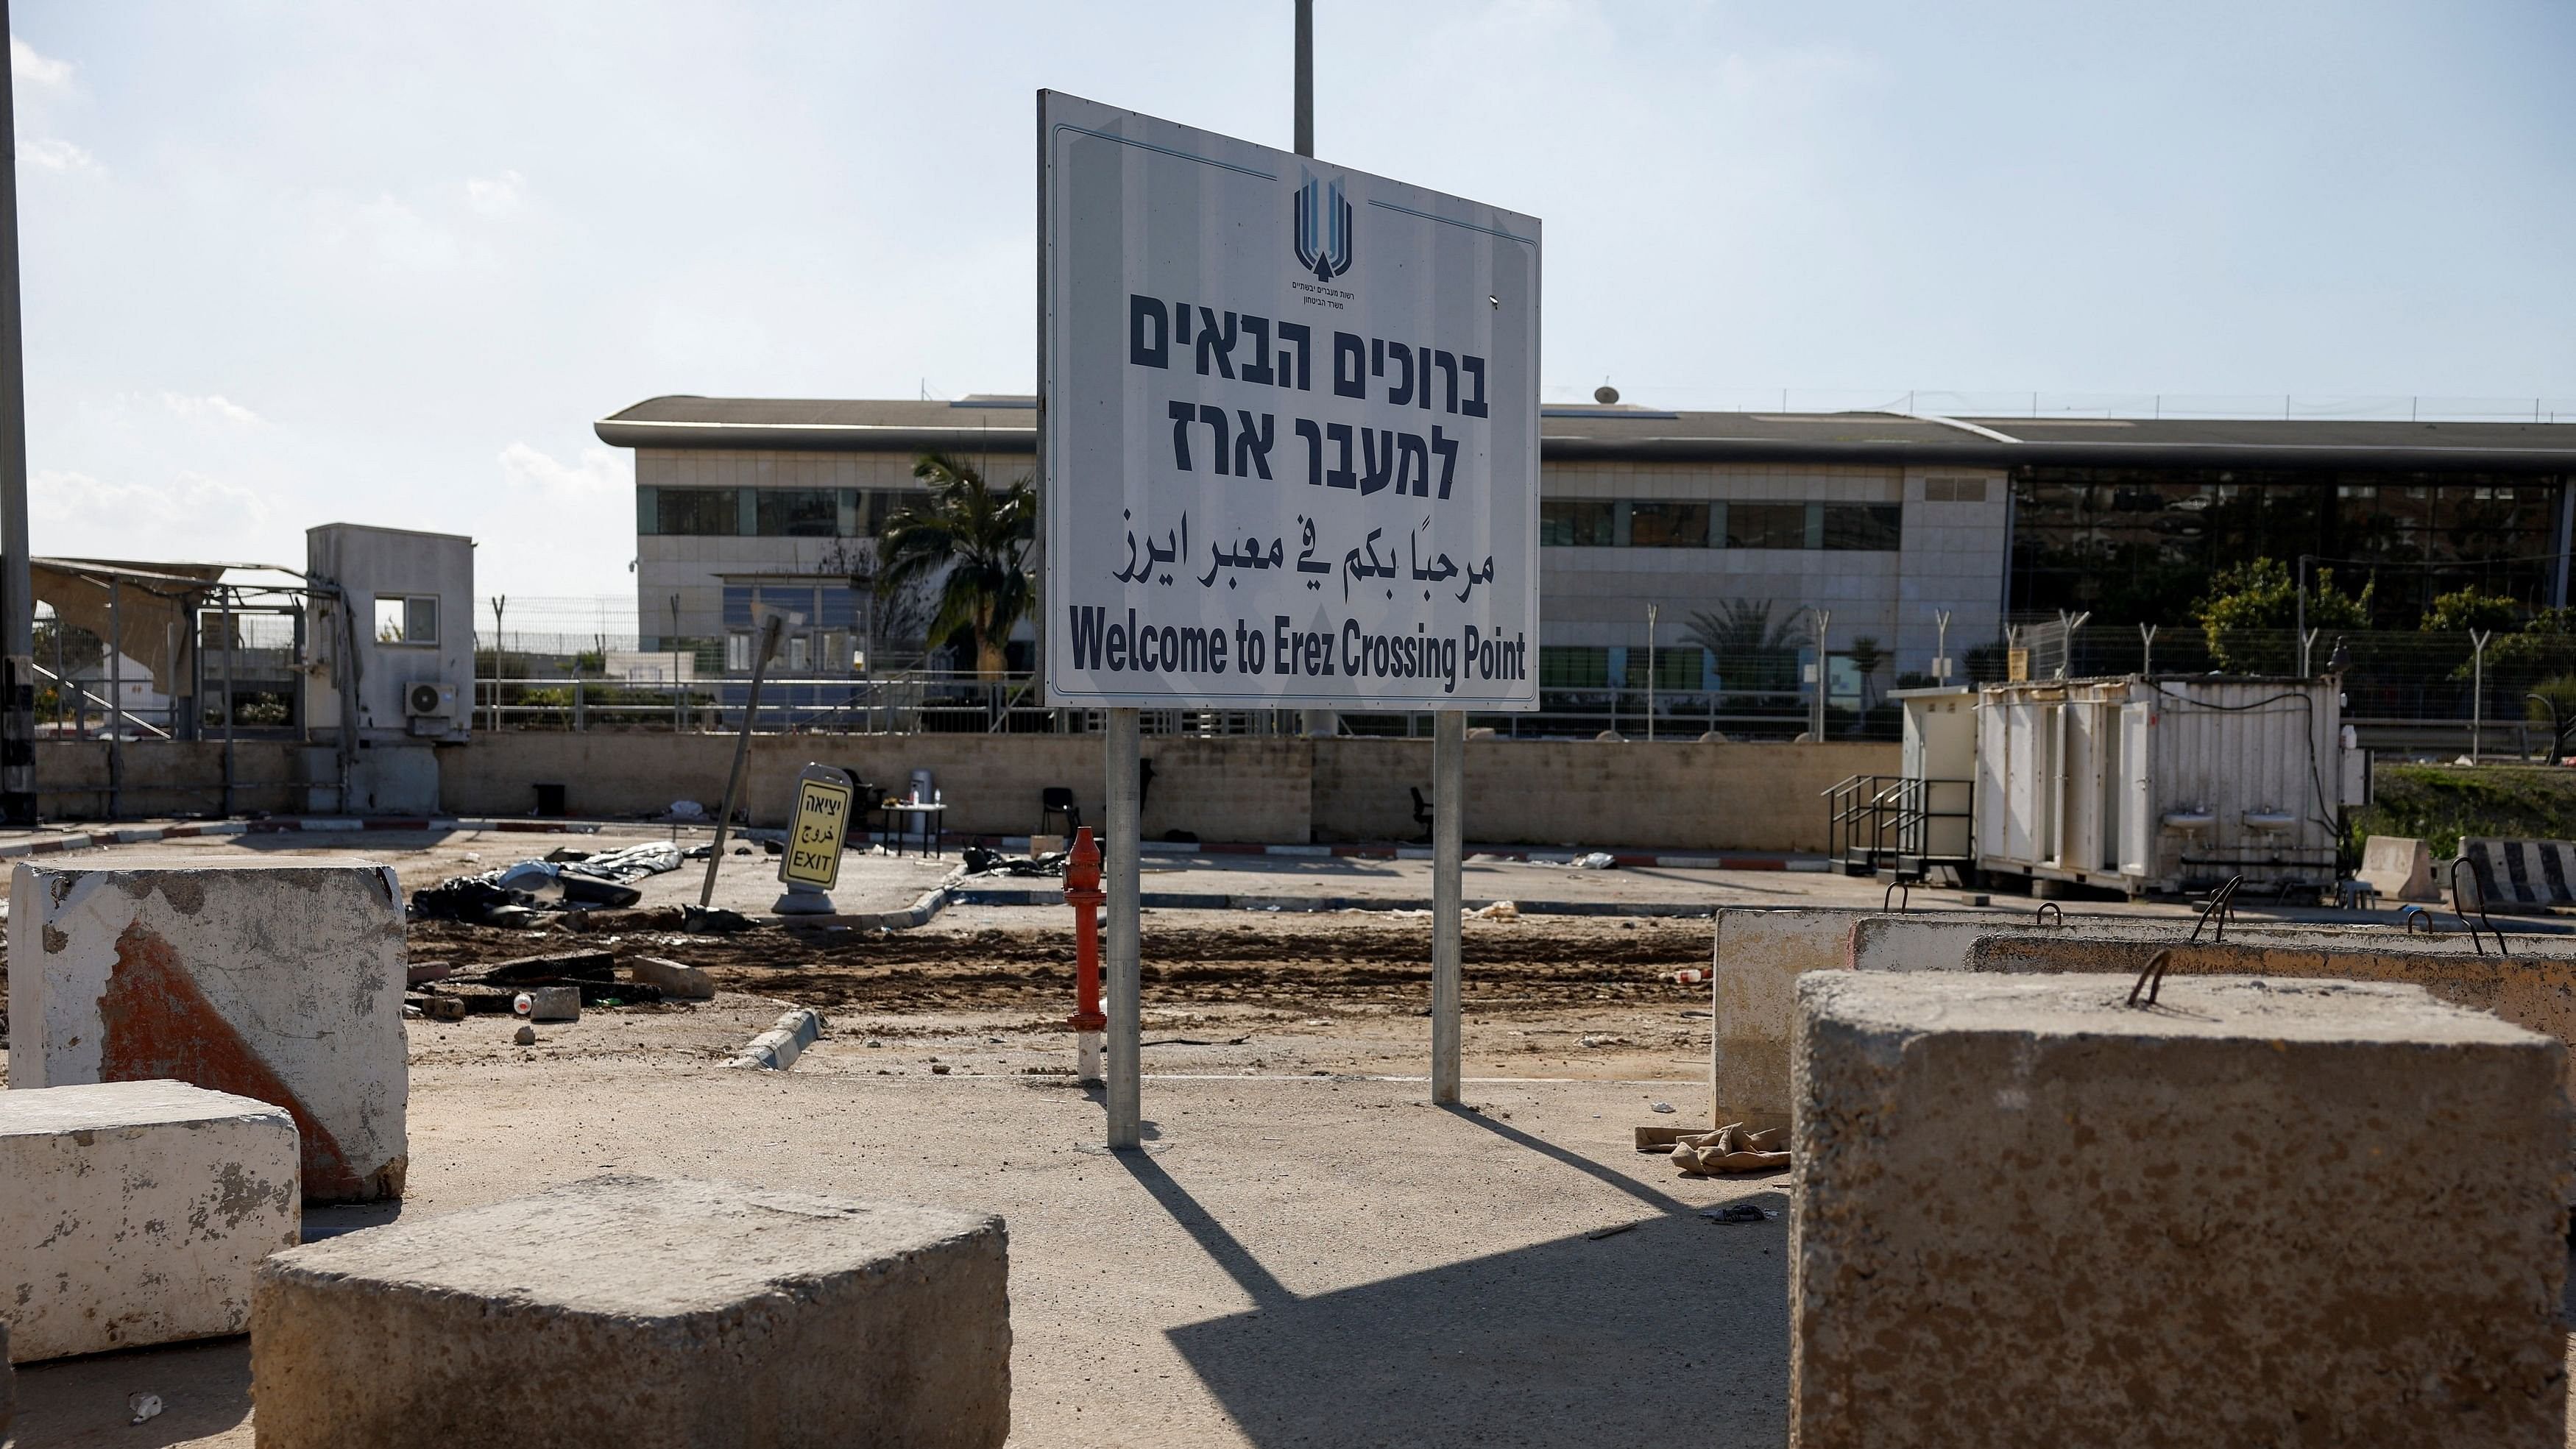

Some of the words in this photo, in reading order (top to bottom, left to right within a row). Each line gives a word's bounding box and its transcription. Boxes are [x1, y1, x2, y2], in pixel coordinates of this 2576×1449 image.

[1292, 281, 1315, 292] יבשתיים
[1303, 296, 1326, 306] הביטחון
[1317, 286, 1338, 297] מעברים
[1327, 300, 1343, 310] משרד
[1340, 291, 1354, 300] רשות
[1130, 294, 1311, 392] הבאים
[1334, 330, 1488, 419] ברוכים
[1168, 400, 1275, 481] ארז
[1295, 417, 1459, 500] למעבר
[1112, 508, 1188, 587] ايرز
[1196, 537, 1284, 590] معبر
[1296, 514, 1331, 592] في
[1342, 527, 1397, 605] بكم
[1069, 605, 1228, 674] Welcome
[1235, 618, 1266, 675] to
[1274, 614, 1335, 677] Erez
[1342, 618, 1457, 694] Crossing
[1464, 624, 1526, 681] Point
[806, 795, 841, 816] יציאה
[793, 851, 832, 871] EXIT
[802, 825, 834, 844] خروج
